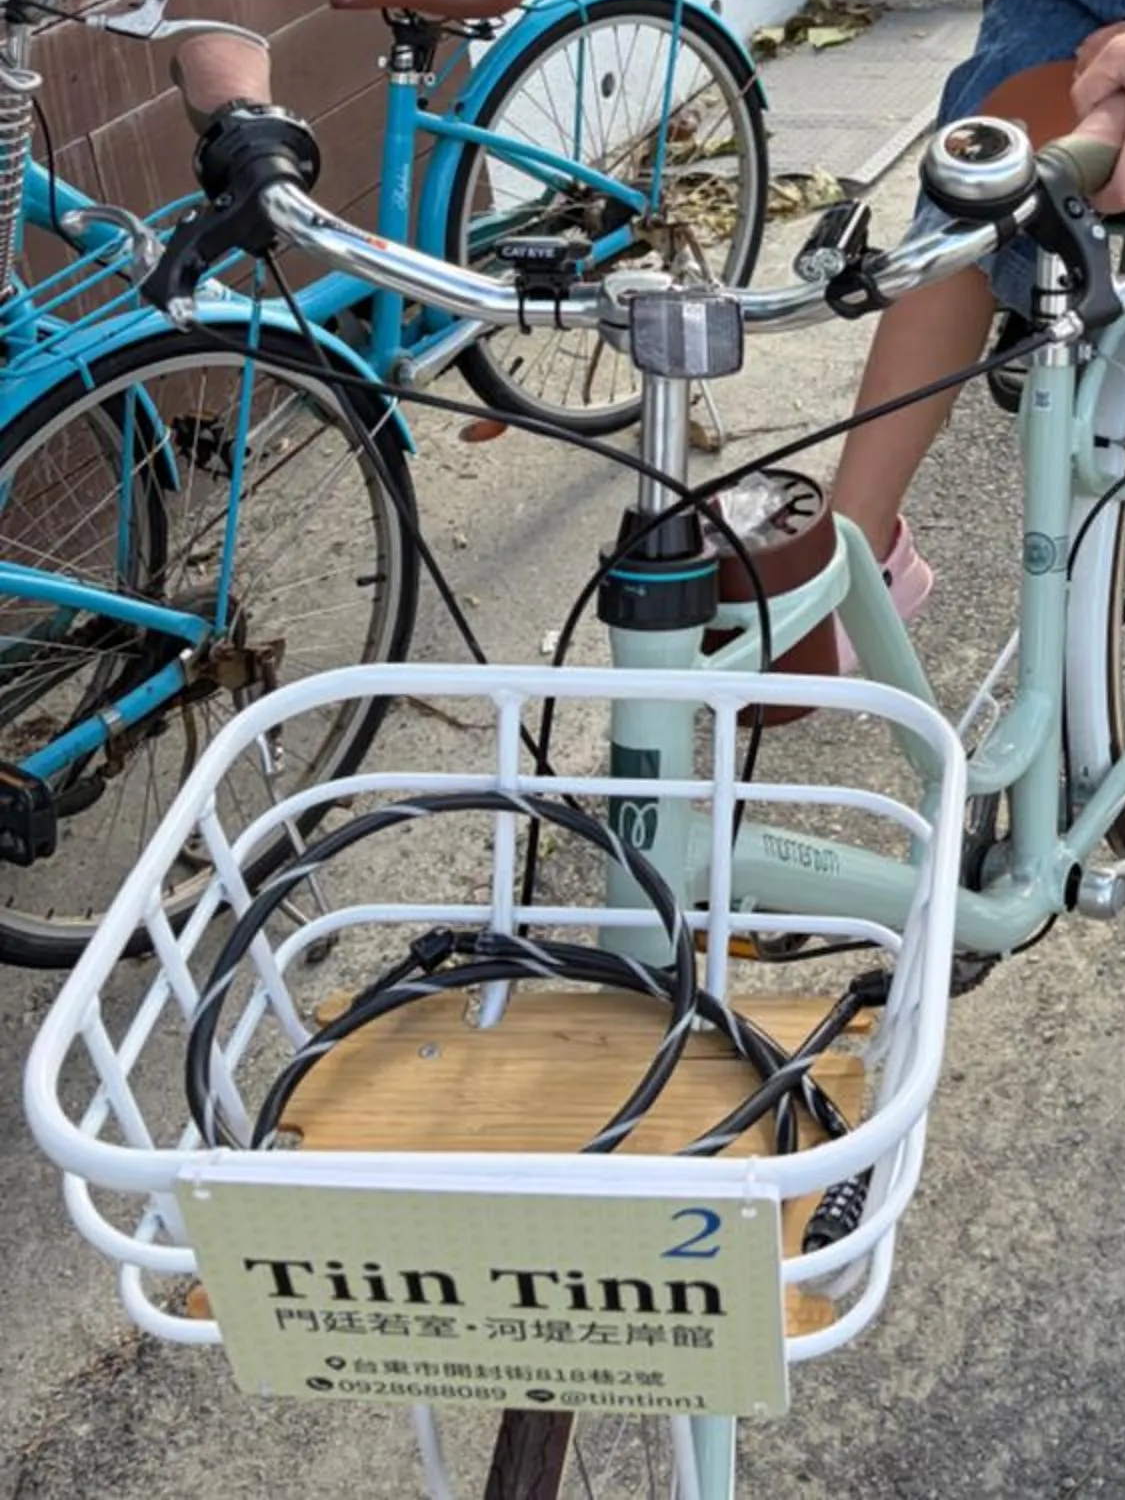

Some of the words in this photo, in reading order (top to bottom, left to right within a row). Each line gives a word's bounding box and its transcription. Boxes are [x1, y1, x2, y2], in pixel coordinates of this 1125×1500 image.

[660, 1207, 722, 1260] 2
[243, 1258, 466, 1306] Tiin
[489, 1268, 728, 1317] Tinn
